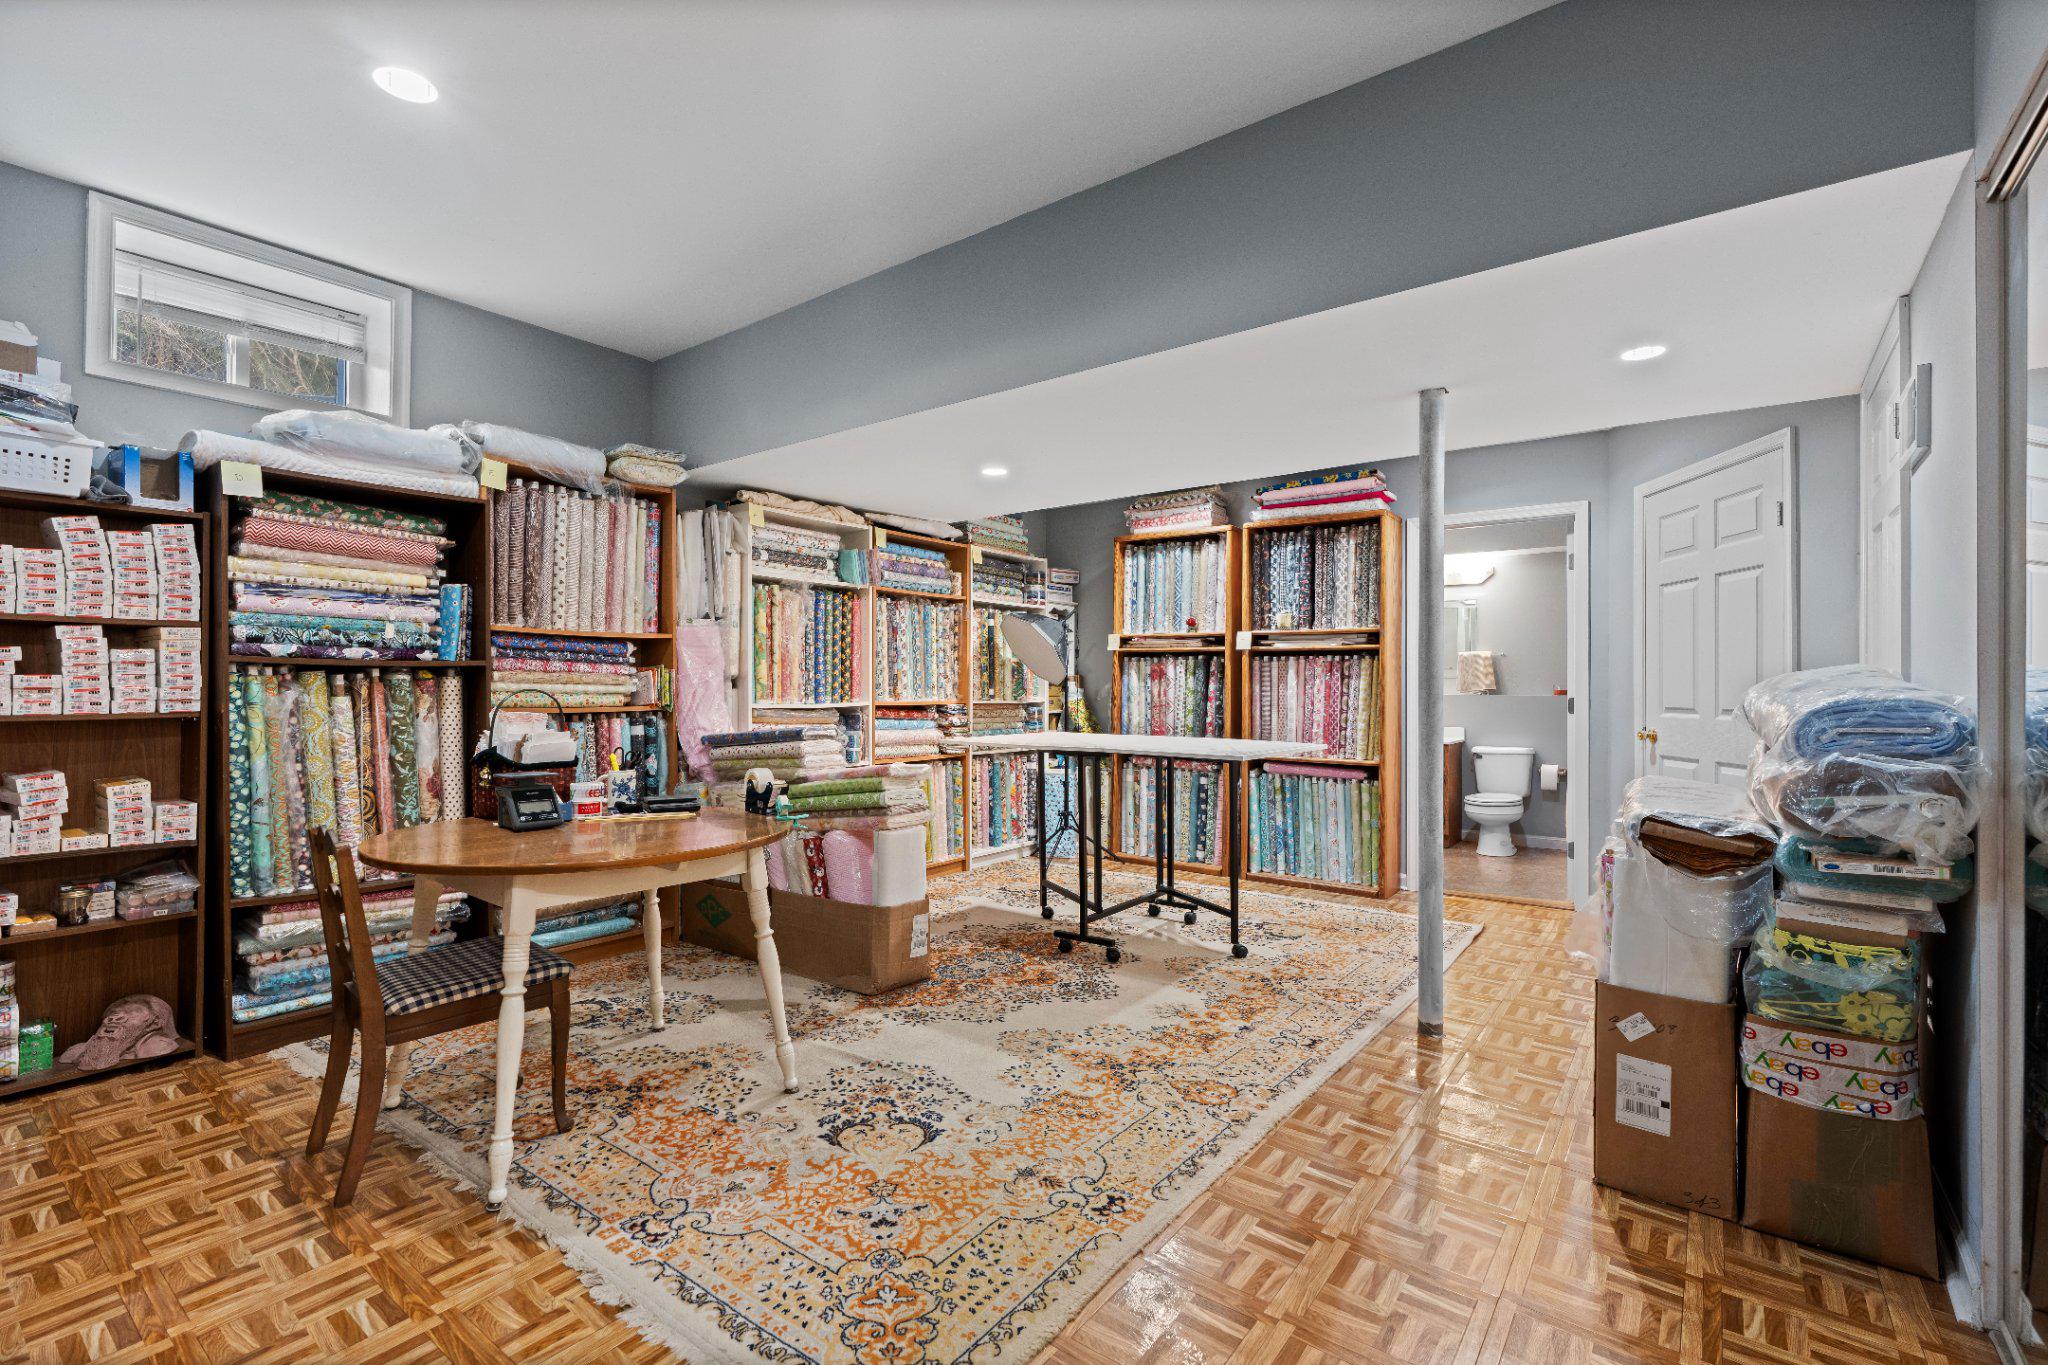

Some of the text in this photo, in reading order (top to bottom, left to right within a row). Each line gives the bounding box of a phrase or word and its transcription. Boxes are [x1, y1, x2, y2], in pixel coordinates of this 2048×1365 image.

[1779, 1032, 1848, 1060] ebay
[1754, 1051, 1909, 1100] ebay ebay
[1822, 1094, 1892, 1118] ebay
